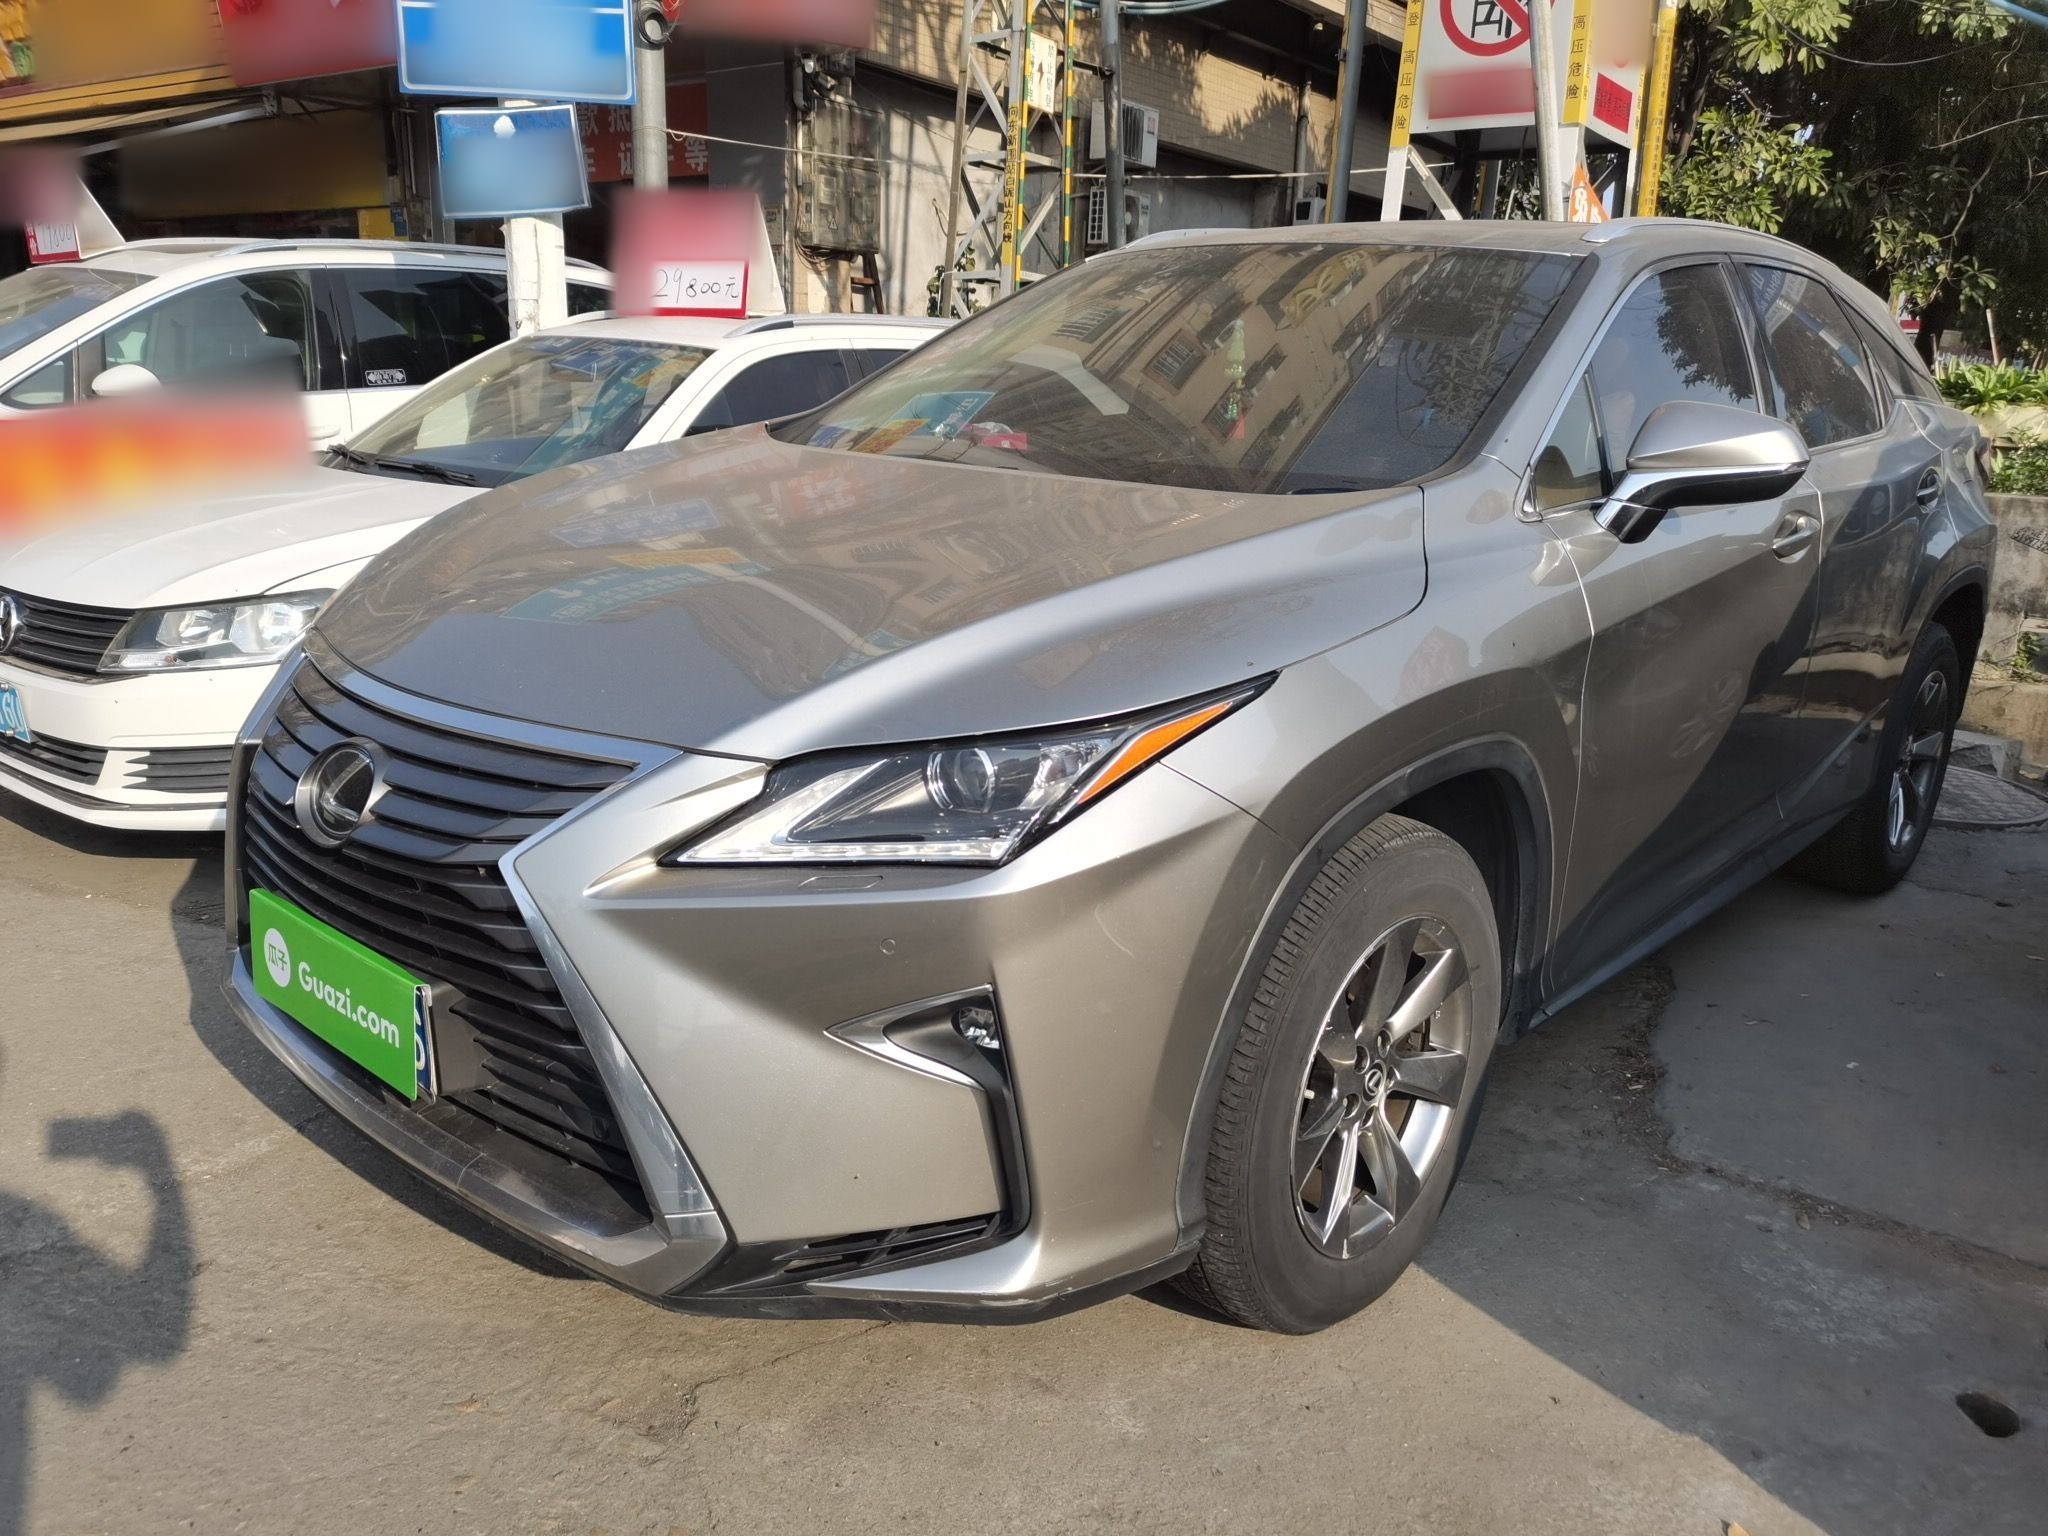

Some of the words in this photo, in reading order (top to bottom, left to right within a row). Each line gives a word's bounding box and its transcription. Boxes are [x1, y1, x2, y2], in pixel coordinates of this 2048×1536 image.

[1408, 0, 1421, 26] 登
[1394, 49, 1417, 129] 高压危险
[1566, 15, 1587, 100] 高压危险
[268, 943, 288, 972] 瓜子
[298, 961, 400, 1049] Guazi.com
